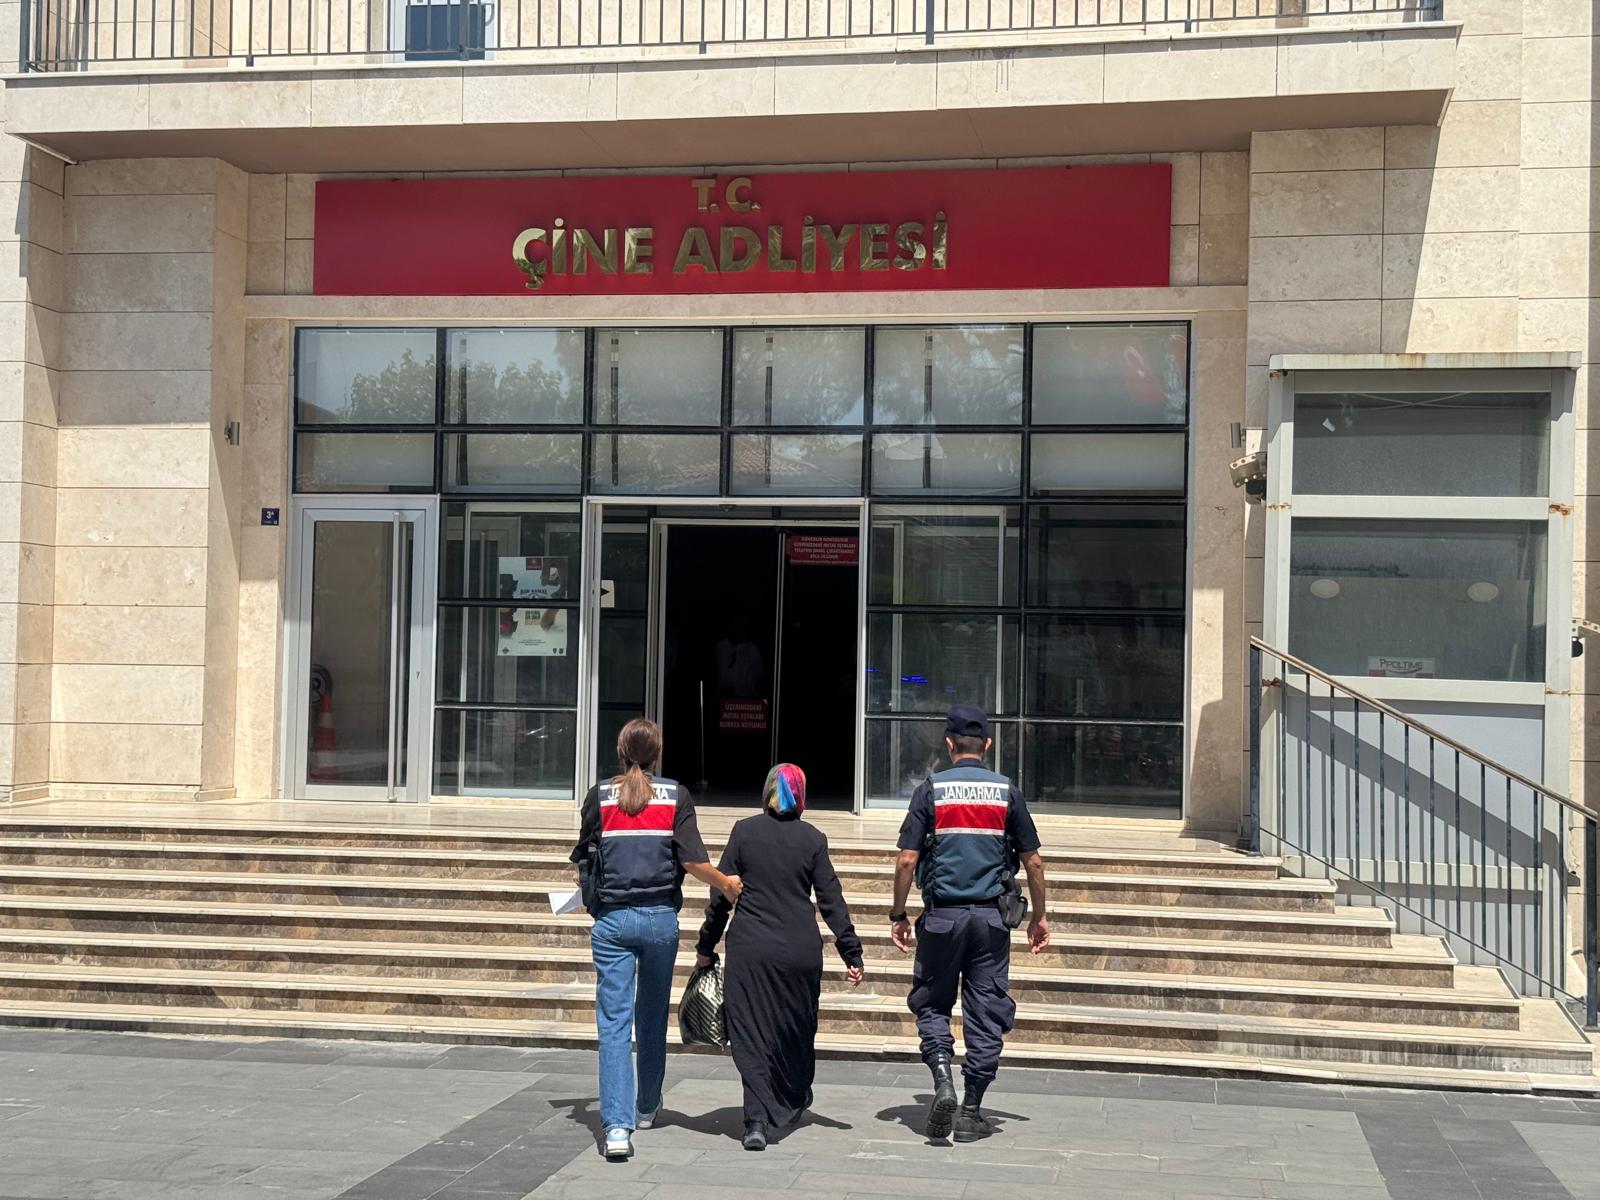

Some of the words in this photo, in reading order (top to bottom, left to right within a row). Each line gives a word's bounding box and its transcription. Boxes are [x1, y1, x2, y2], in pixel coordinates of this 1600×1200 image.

[691, 176, 762, 213] T.C.
[511, 217, 654, 290] ÇİNE
[672, 210, 948, 275] ADLİYESİ
[607, 786, 669, 800] JAMA
[941, 785, 1002, 801] JANDARMA
